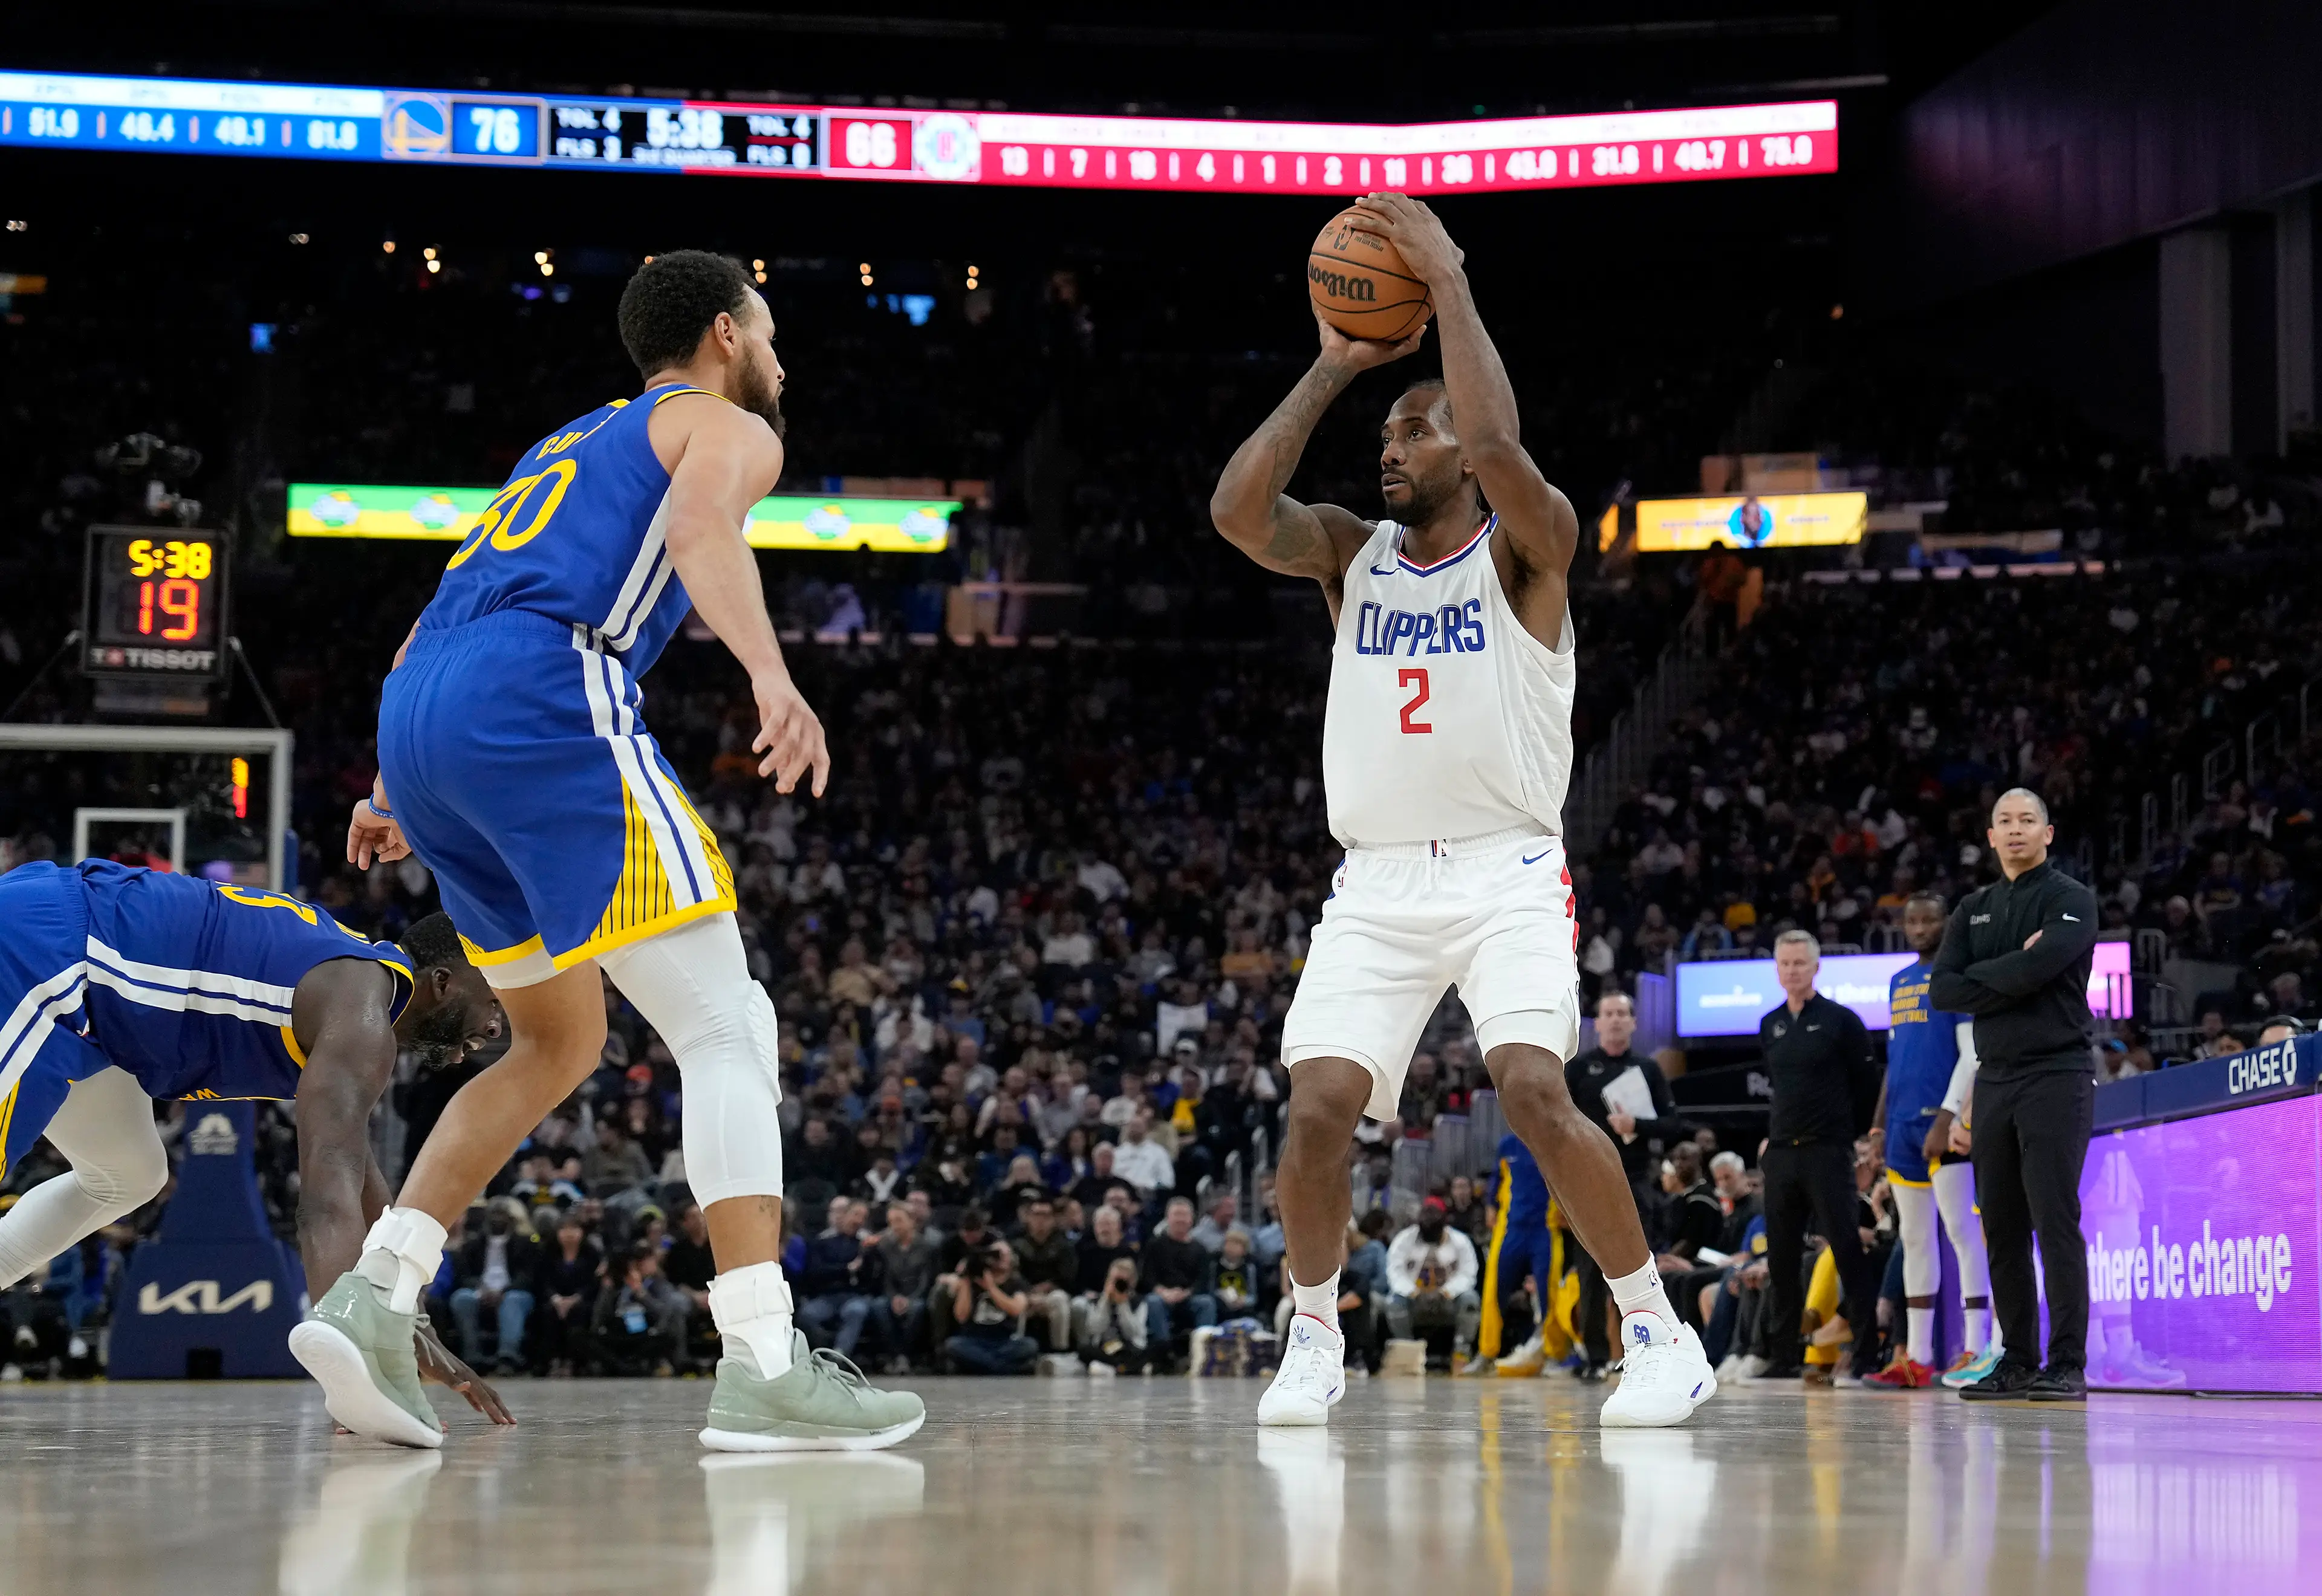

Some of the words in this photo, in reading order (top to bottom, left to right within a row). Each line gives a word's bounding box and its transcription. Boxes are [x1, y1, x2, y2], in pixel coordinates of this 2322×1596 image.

[470, 107, 521, 154] 76
[646, 107, 724, 149] 5:38
[845, 122, 897, 168] 66
[1195, 152, 1217, 182] 4
[1323, 155, 1343, 186] 2
[128, 539, 212, 580] 5:38
[138, 579, 199, 641] 19
[1355, 598, 1486, 657] CLIPPERS
[126, 647, 216, 670] TISSOT
[1397, 668, 1433, 734] 2
[2228, 1047, 2282, 1095] CHASE
[2087, 1231, 2150, 1304] there
[2152, 1224, 2185, 1300] be
[2187, 1219, 2293, 1312] change
